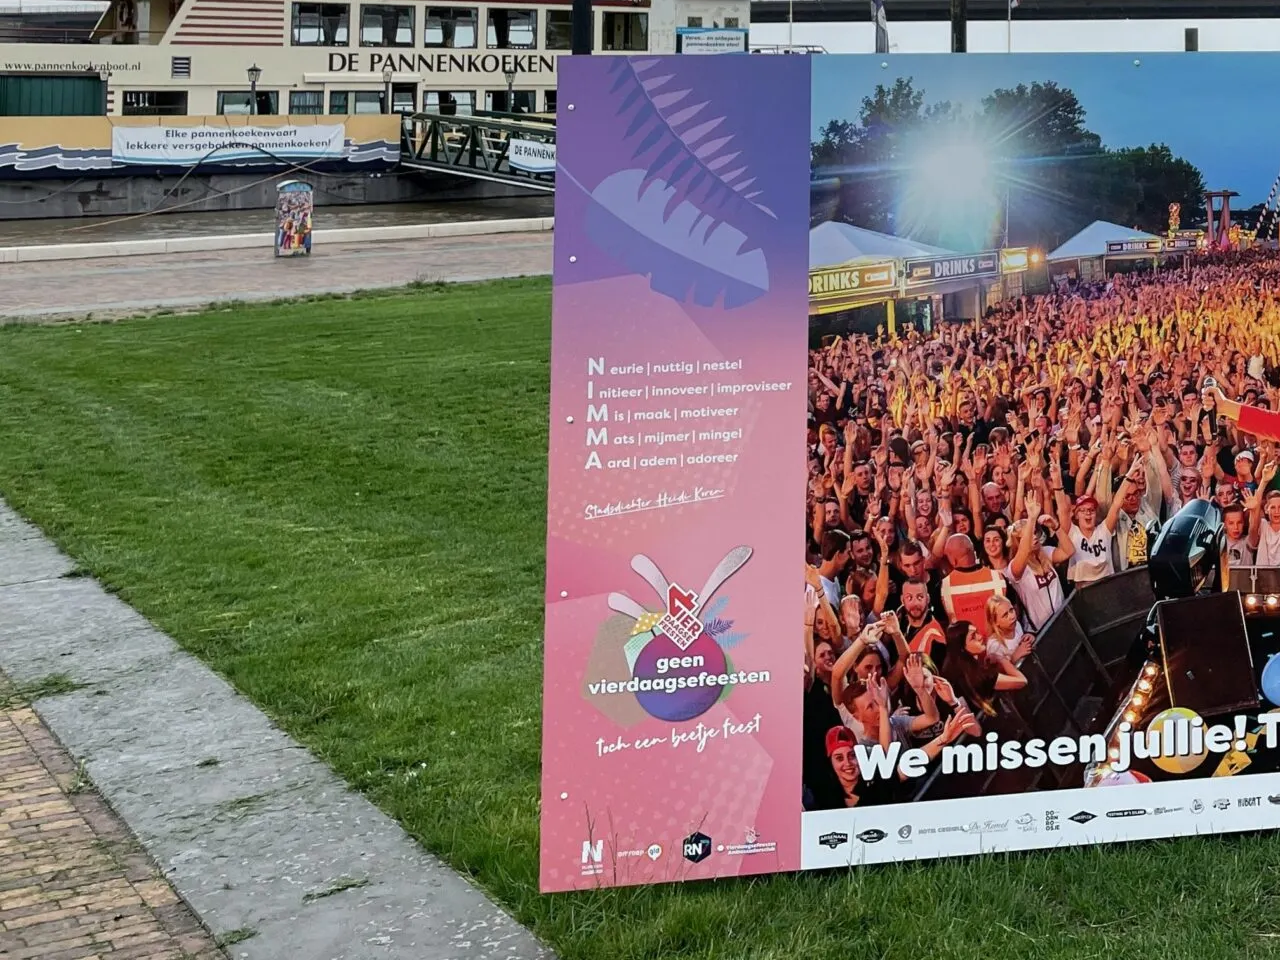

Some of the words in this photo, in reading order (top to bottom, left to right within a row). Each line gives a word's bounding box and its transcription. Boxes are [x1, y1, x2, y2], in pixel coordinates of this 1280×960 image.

[4, 61, 141, 71] www.pannenkoekenboot.nl
[328, 53, 359, 72] DE
[370, 53, 554, 73] PANNENKOEKEN
[165, 129, 188, 139] Elke
[191, 128, 298, 139] pannenkoekenvaart
[126, 141, 169, 150] lekkere
[251, 139, 332, 150] pannenkoeken!
[514, 145, 523, 156] DE
[934, 258, 975, 278] DRINKS
[653, 360, 694, 374] nuttig
[702, 359, 742, 371] nestel
[599, 387, 643, 399] nitieer
[652, 385, 708, 397] innoveer
[717, 380, 793, 395] improviseer
[614, 410, 625, 422] is
[634, 408, 672, 420] maak
[680, 406, 739, 418] motiveer
[613, 434, 635, 445] ats
[644, 430, 690, 446] mijmer
[698, 428, 743, 442] mingel
[607, 456, 631, 469] ard
[639, 455, 678, 467] adem
[686, 452, 738, 465] adoreer
[658, 621, 687, 647] FEESTEN
[664, 614, 693, 642] DAAGSE
[656, 655, 705, 673] geen
[588, 670, 770, 694] vierdaagsefeesten
[635, 737, 668, 750] een
[671, 722, 720, 753] beetje
[722, 713, 763, 739] feest
[854, 741, 929, 782] We
[941, 731, 1107, 774] missen
[1110, 714, 1248, 773] jullie!
